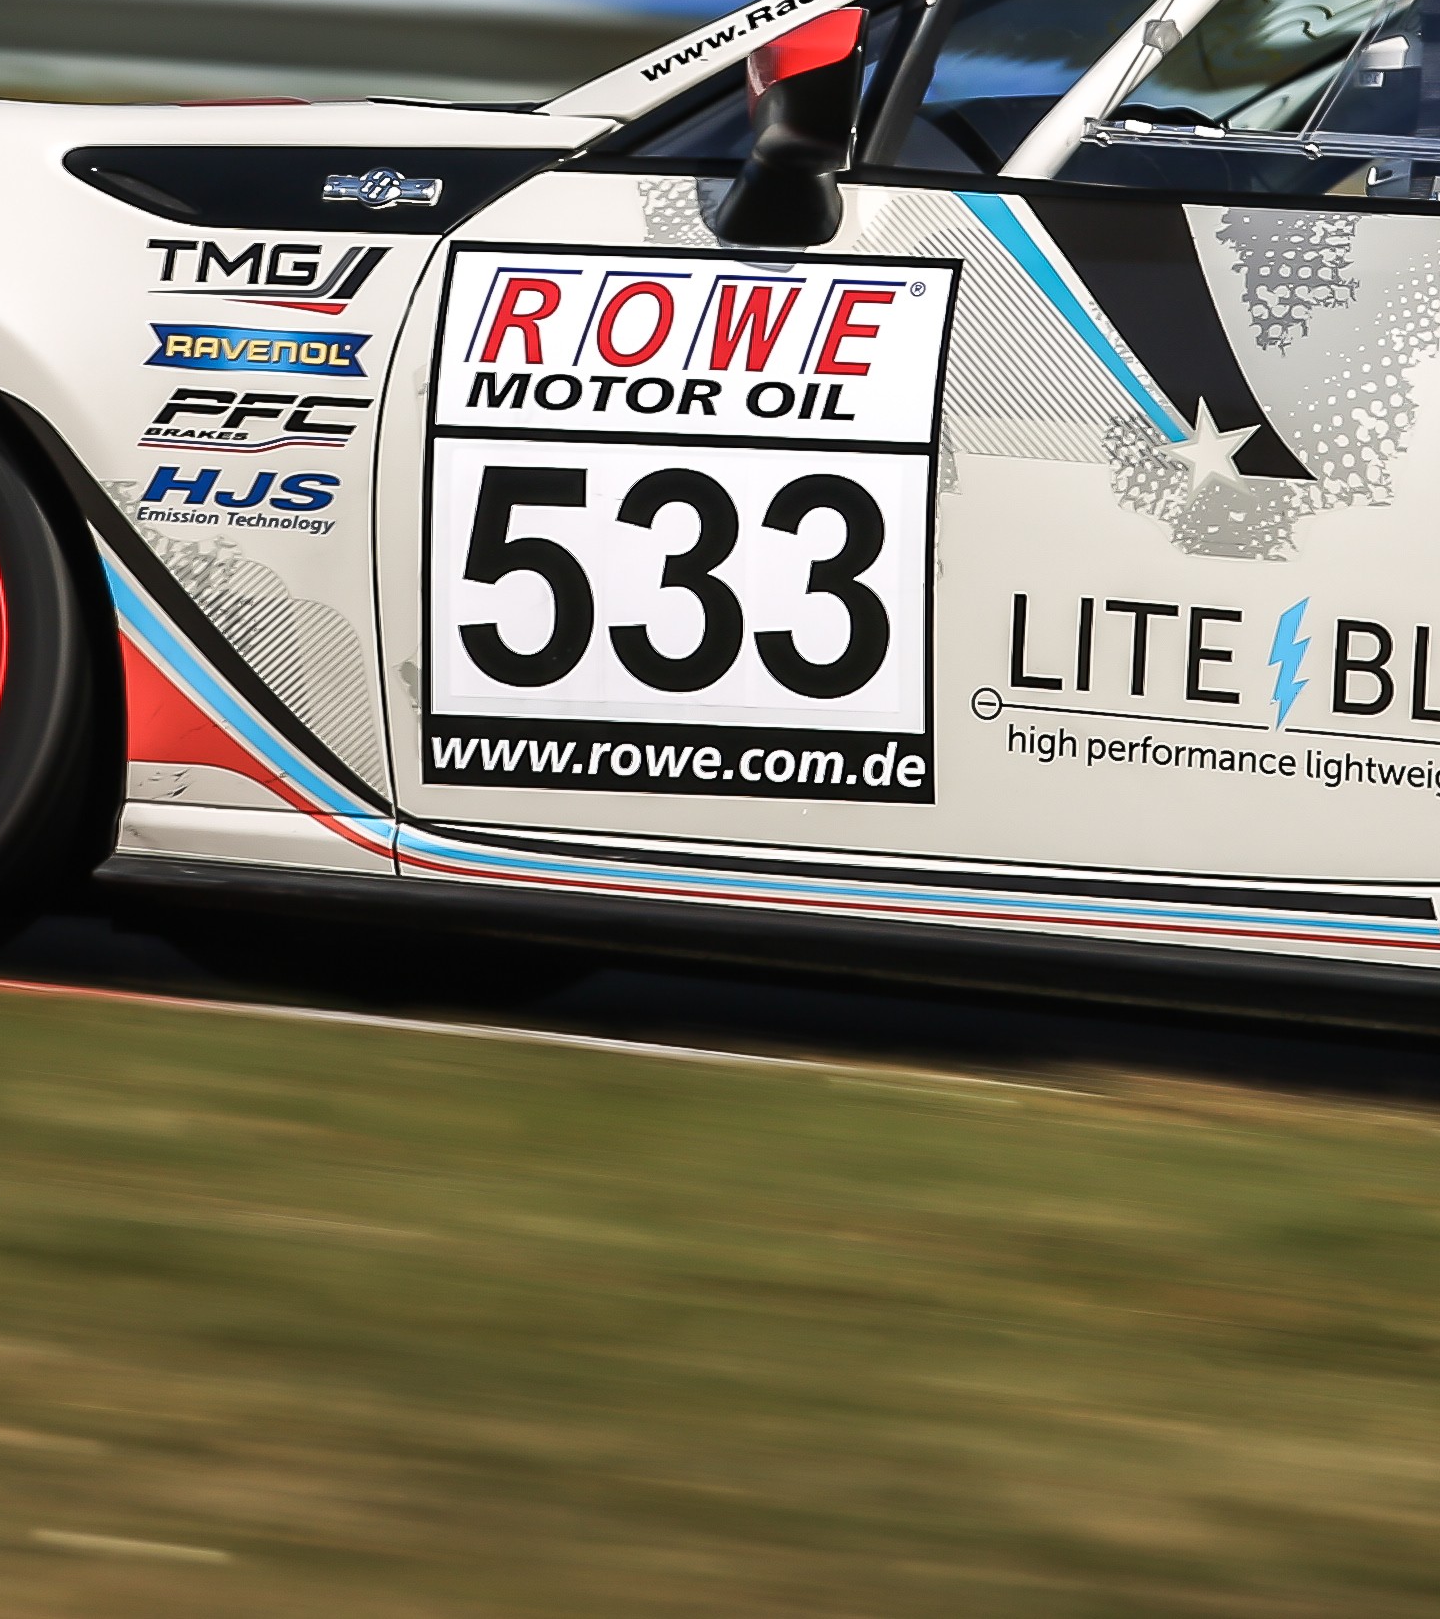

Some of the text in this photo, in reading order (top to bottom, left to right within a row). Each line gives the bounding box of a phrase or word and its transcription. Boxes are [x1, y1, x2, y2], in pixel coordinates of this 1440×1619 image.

[147, 239, 322, 286] TMG
[465, 268, 907, 376] ROWE
[165, 335, 352, 367] RAVENOL
[152, 388, 374, 435] PFC
[465, 371, 858, 422] MOTOR OIL
[144, 428, 248, 441] BRAKES
[141, 466, 340, 511] HJS
[137, 506, 336, 535] Emission Technology
[458, 465, 890, 699] 533
[1009, 592, 1243, 705] LITE
[430, 736, 925, 787] www.rowe.com.de
[1007, 723, 1077, 762] high
[1087, 733, 1296, 778] performance
